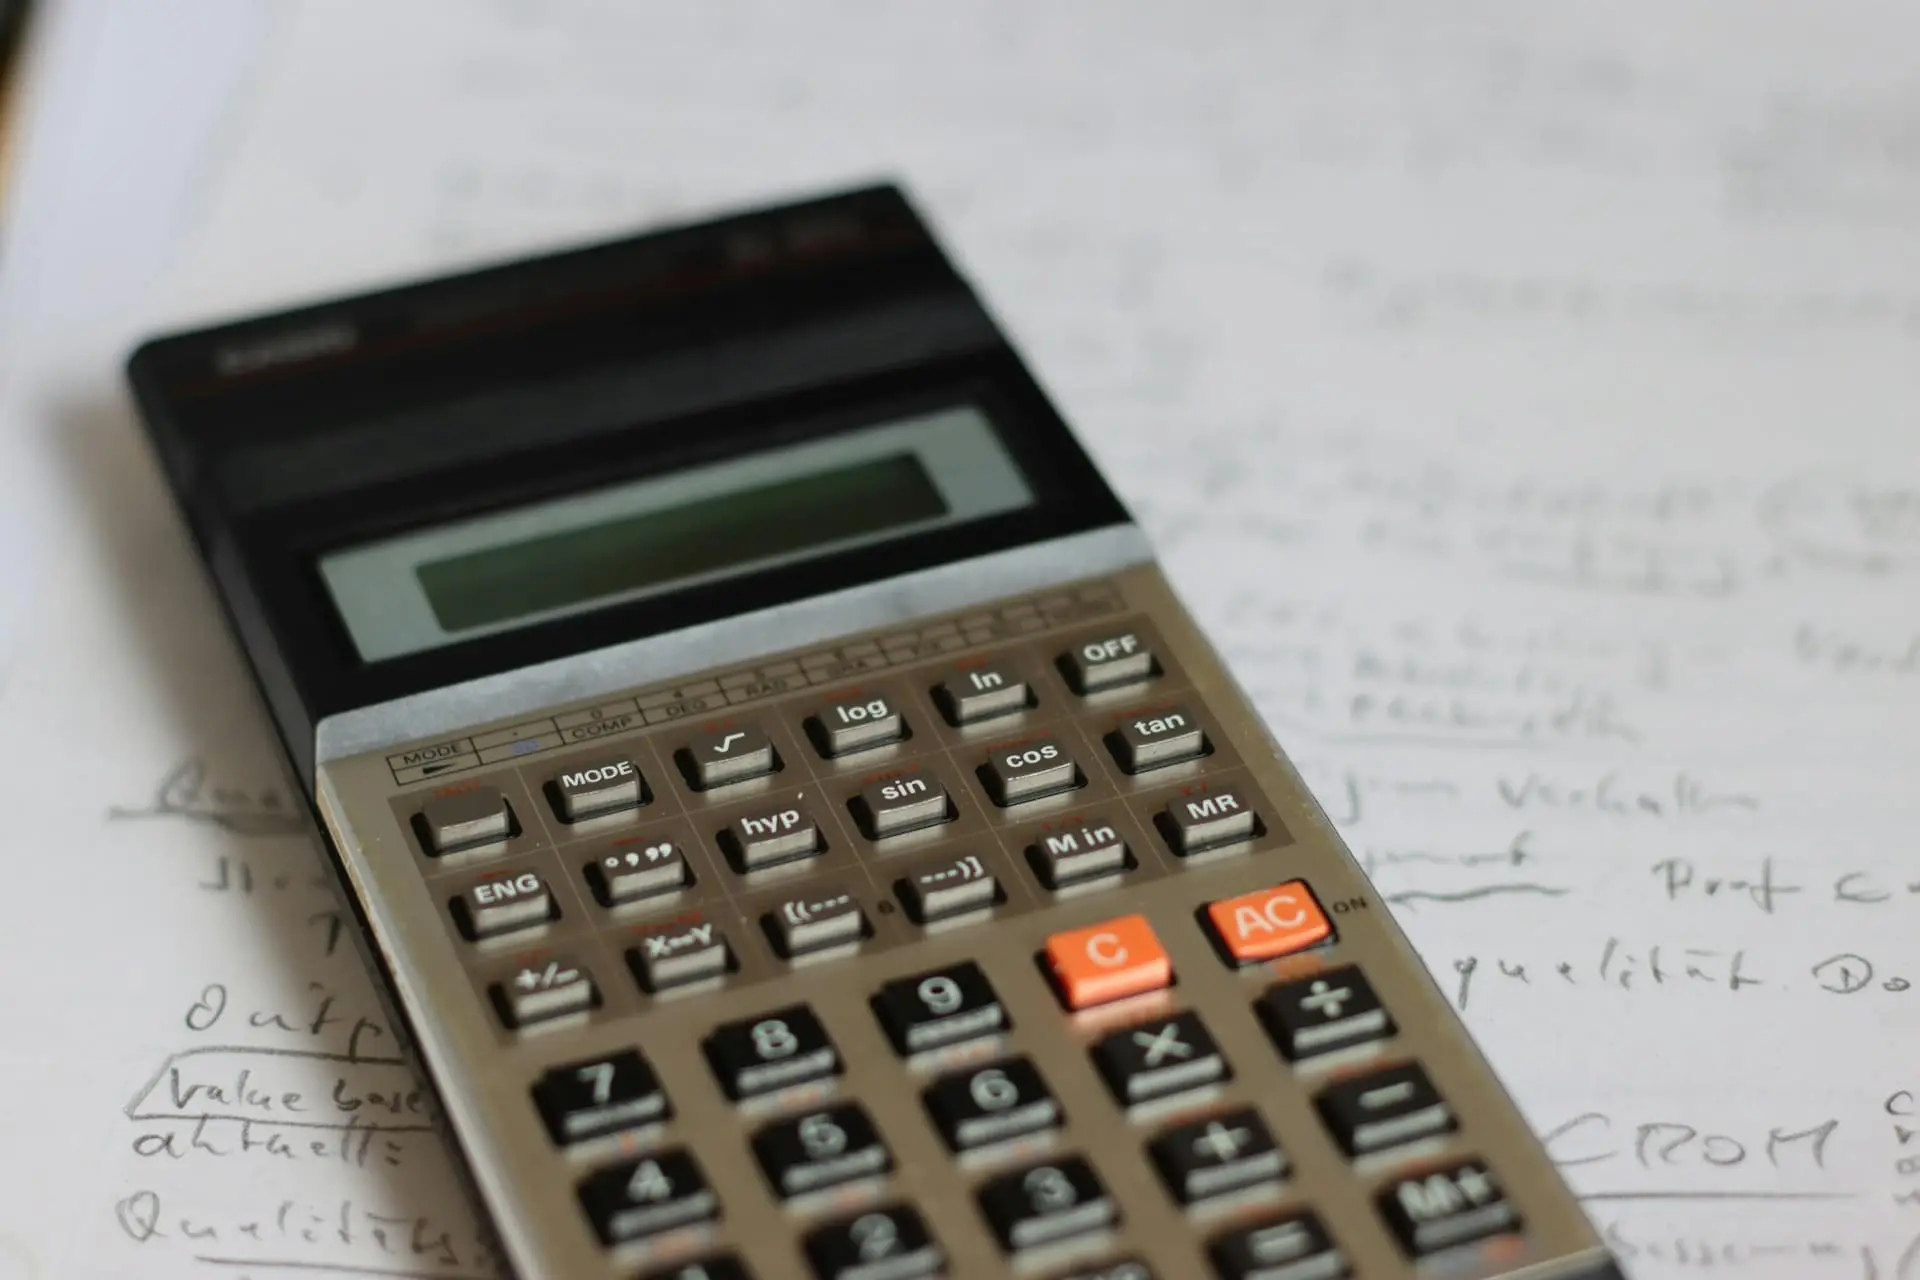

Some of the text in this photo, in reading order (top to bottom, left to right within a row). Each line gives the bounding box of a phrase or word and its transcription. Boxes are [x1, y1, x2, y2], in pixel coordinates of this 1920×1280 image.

[1083, 634, 1139, 662] OFF
[665, 699, 708, 718] DEG
[837, 699, 889, 723] log
[571, 716, 633, 740] COMP
[1134, 710, 1186, 737] tan
[402, 742, 464, 766] MODE
[1005, 744, 1059, 769] cos
[561, 760, 634, 789] MODE
[881, 776, 927, 801] sin
[1185, 793, 1240, 820] MR
[740, 809, 800, 836] hyp
[473, 873, 541, 904] ENG
[1232, 892, 1307, 940] AC
[1332, 894, 1369, 918] ON
[1084, 932, 1129, 967] C
[577, 1062, 617, 1103] 7
[750, 1018, 799, 1060] 8
[916, 975, 963, 1014] 9
[170, 1067, 306, 1113] Value
[627, 1158, 676, 1202] 4
[798, 1112, 848, 1159] 5
[969, 1068, 1019, 1112] 6
[849, 1213, 898, 1260] 2
[1023, 1165, 1076, 1212] 3
[1398, 1167, 1497, 1220] M+
